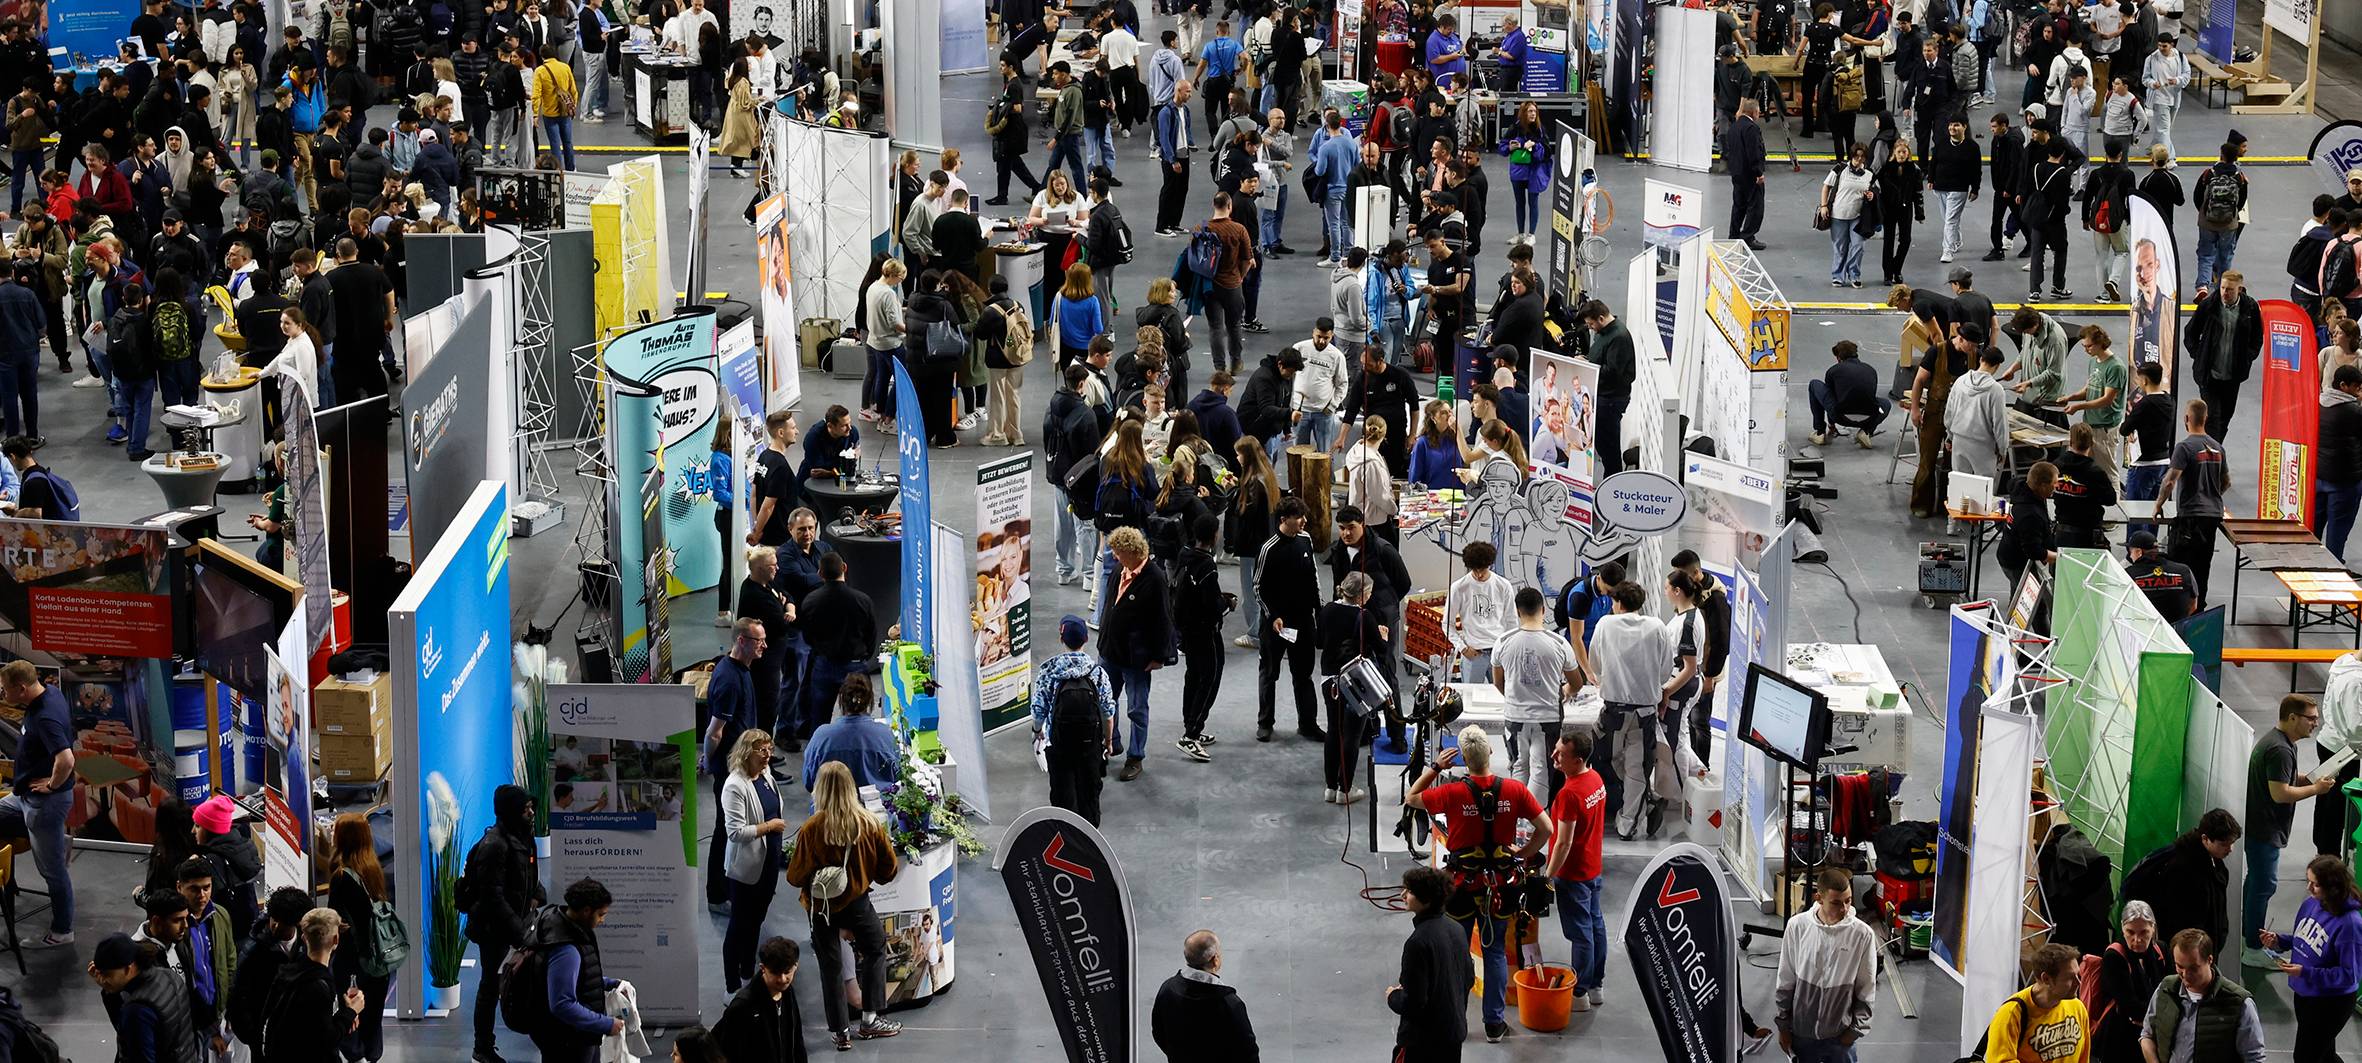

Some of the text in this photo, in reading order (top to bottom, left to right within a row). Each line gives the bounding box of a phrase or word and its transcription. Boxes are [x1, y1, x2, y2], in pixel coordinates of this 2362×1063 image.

[674, 323, 696, 333] AUTO
[1753, 320, 1785, 351] H!
[640, 331, 694, 353] THOMAS
[641, 342, 691, 361] FIRMENGRUPPE
[683, 384, 697, 401] IM
[423, 374, 458, 438] GIERATHS
[684, 466, 713, 495] YEA
[981, 460, 1028, 482] JETZT BEWERBEN!
[1747, 477, 1768, 490] BELZ
[2055, 482, 2088, 495] TAUF
[1613, 490, 1673, 504] Stuckateur
[1623, 504, 1666, 516] & Maler
[2136, 576, 2184, 588] STAUF
[35, 594, 154, 609] Korte Ladenbau-Kompetenzen.
[36, 602, 124, 615] Vielfalt aus einer Hand.
[442, 630, 491, 714] Das Zusammen wirkt.
[560, 697, 588, 719] cjd
[243, 735, 266, 745] MOTO
[576, 815, 638, 823] Berufsbildungswerk
[564, 848, 643, 857] herausFÖRDERN!
[1042, 831, 1113, 987] Vomfell
[1657, 867, 1716, 1005] Vomfell
[1020, 860, 1030, 878] Ihr
[1025, 879, 1053, 947] stahlharter
[1050, 950, 1070, 997] Partner
[1067, 998, 1081, 1023] aus
[1075, 1024, 1088, 1045] der
[1638, 916, 1648, 933] Ihr
[1644, 933, 1671, 992] stahlharter
[1666, 990, 1686, 1035] Partner
[1682, 1031, 1693, 1053] aus
[2030, 1017, 2082, 1051] Humble
